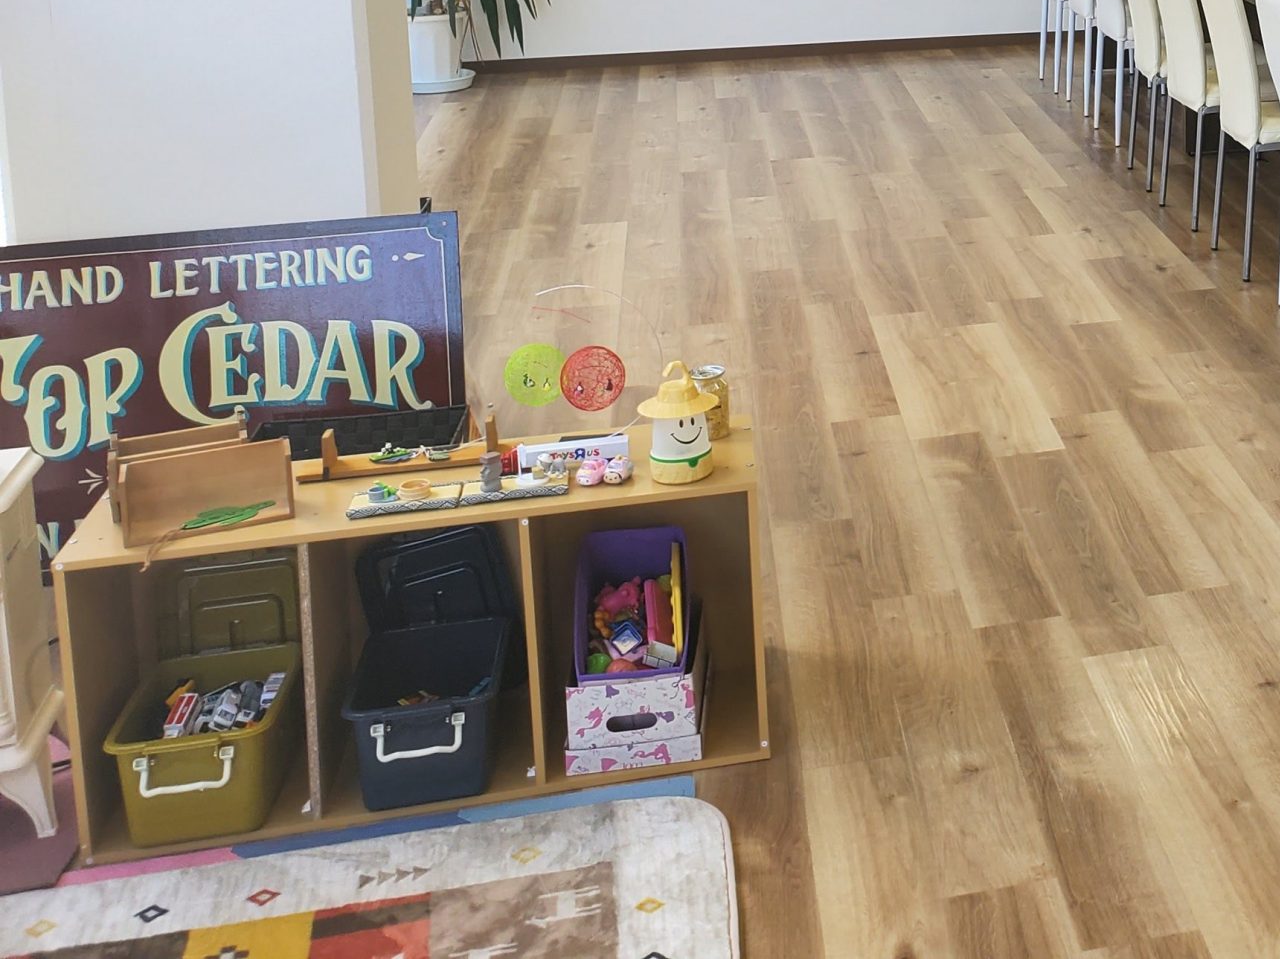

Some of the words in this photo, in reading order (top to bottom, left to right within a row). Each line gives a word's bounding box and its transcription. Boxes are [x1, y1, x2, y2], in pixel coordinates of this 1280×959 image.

[0, 266, 124, 311] HAND
[149, 244, 372, 299] LETTERING
[159, 300, 436, 426] CEDAR
